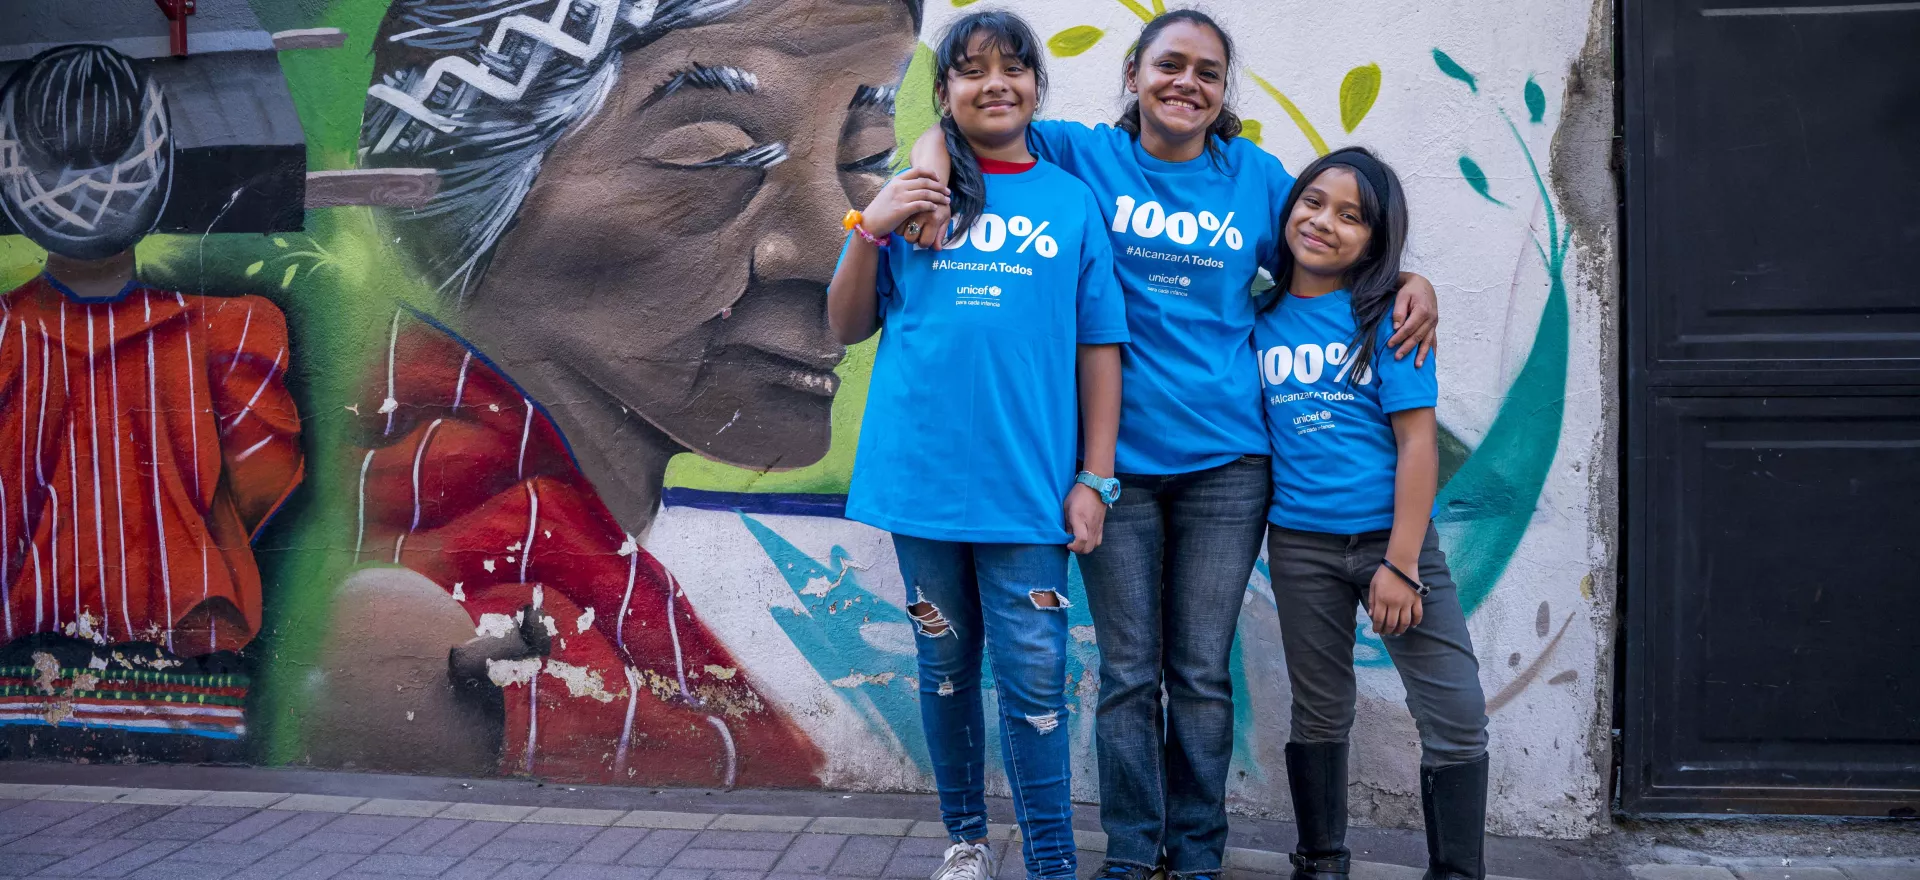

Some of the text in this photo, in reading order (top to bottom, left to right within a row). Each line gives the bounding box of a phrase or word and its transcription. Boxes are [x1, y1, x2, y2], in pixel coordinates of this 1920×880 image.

[1112, 195, 1244, 251] 100%
[913, 213, 1059, 259] 0%
[1126, 246, 1224, 269] #AlcanzarATodos
[932, 260, 1033, 276] #AlcanzarATodos
[1148, 273, 1180, 285] unicef
[956, 284, 989, 295] unicef
[1270, 391, 1355, 406] #AlcanzarATodos
[1292, 411, 1320, 425] unicef
